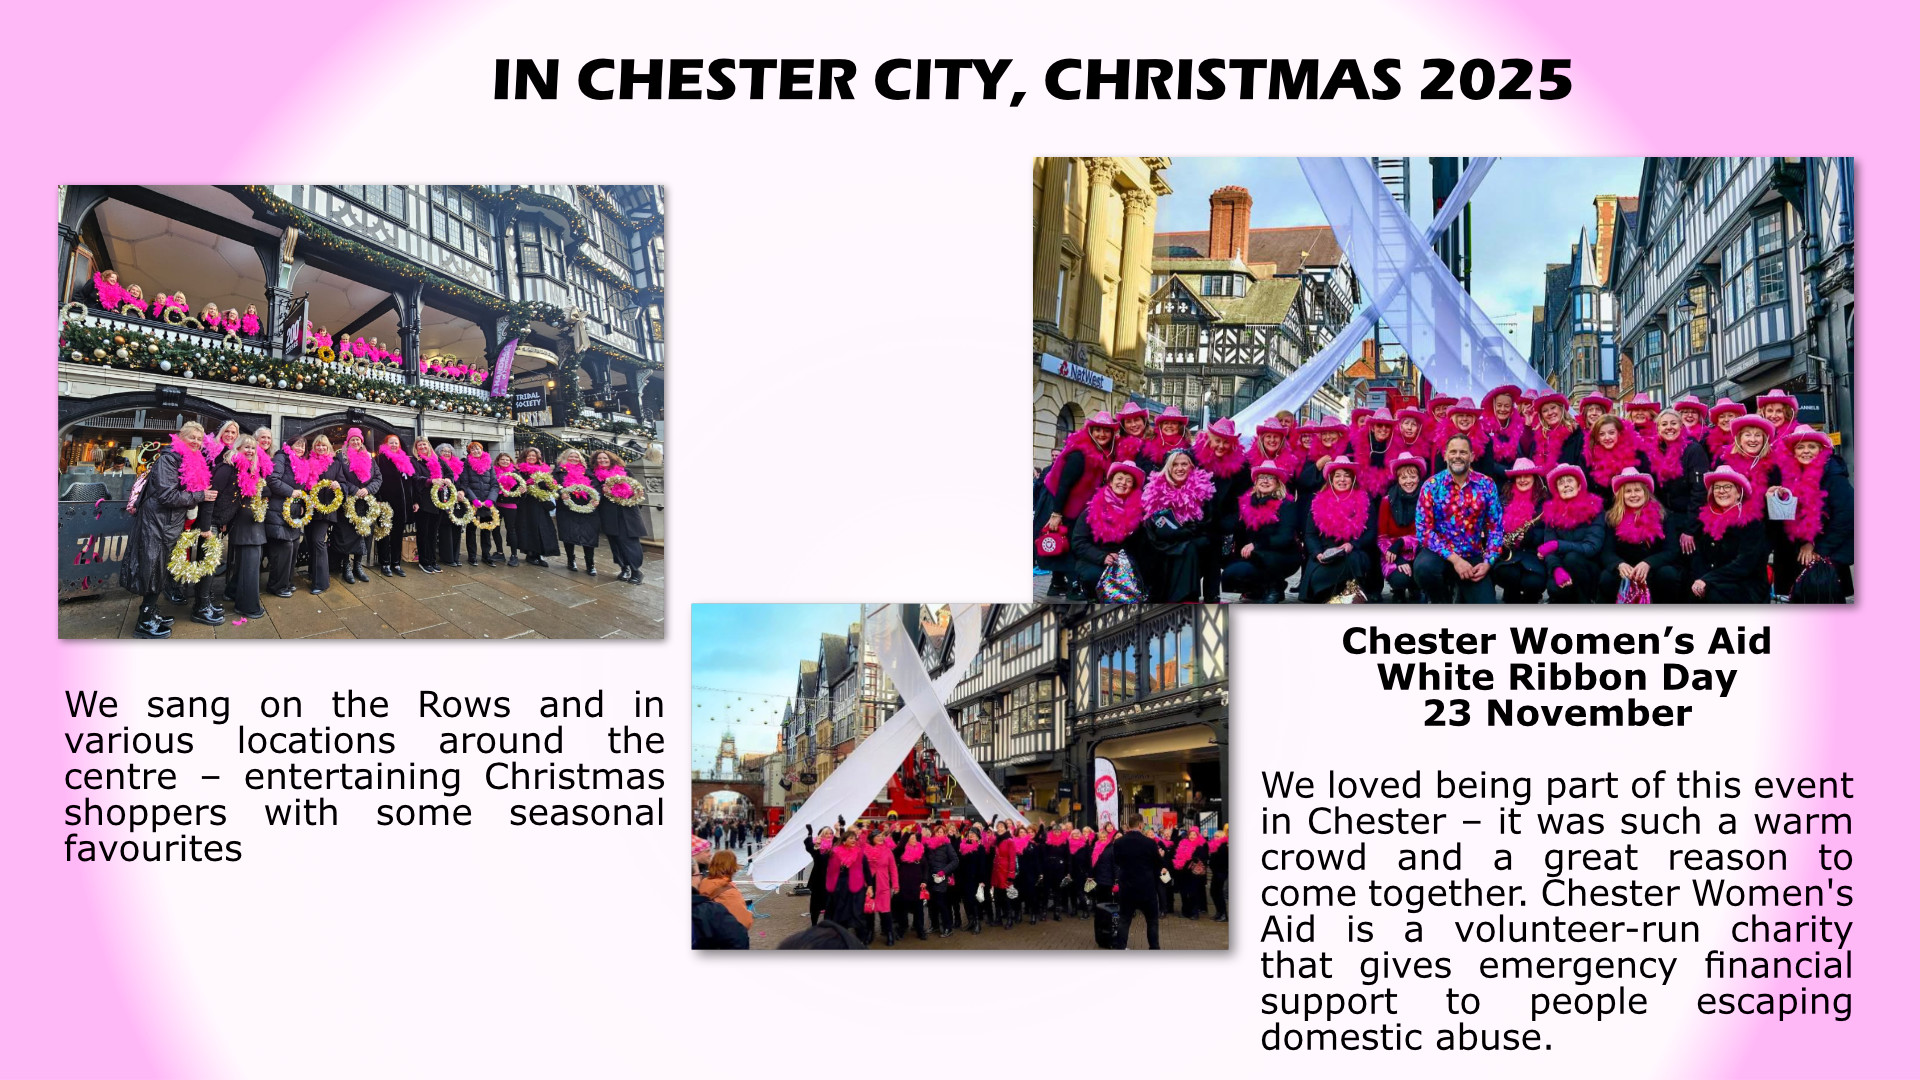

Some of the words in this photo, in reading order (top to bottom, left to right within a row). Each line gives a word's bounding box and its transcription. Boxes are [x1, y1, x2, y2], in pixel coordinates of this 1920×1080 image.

[1070, 364, 1104, 389] NatWest
[516, 391, 541, 401] TRIBAL
[515, 399, 542, 409] SOCIETY
